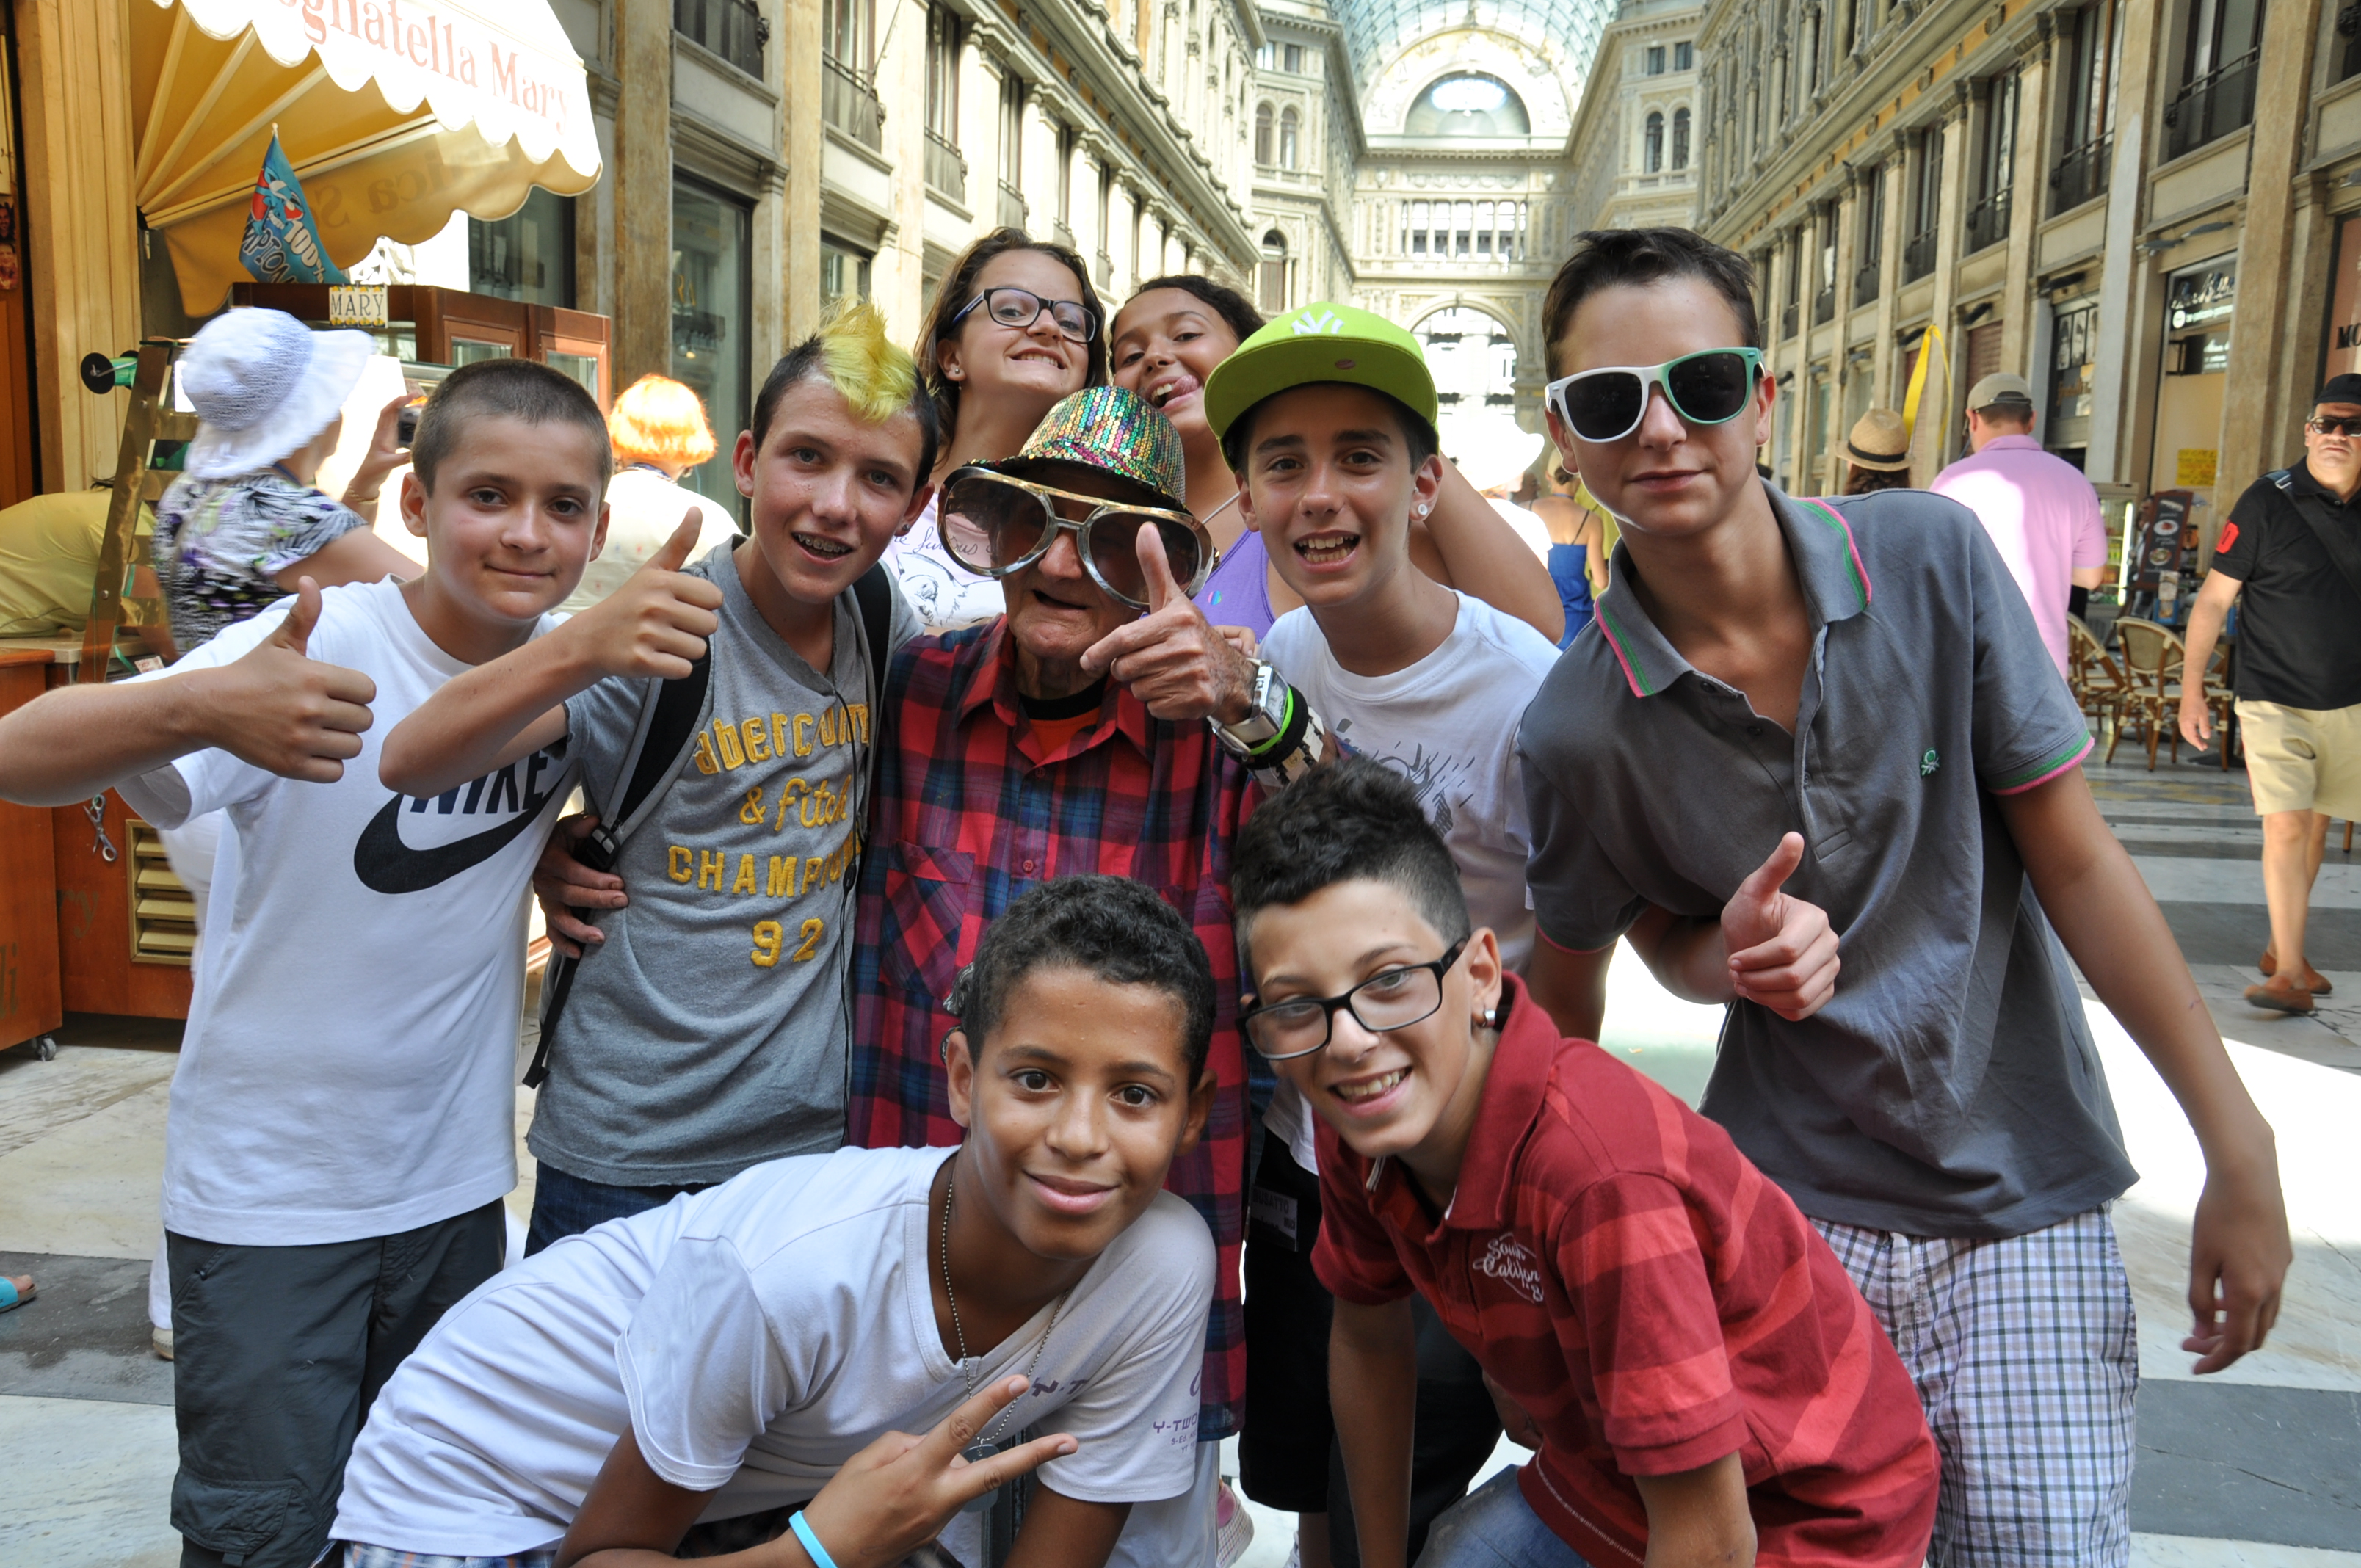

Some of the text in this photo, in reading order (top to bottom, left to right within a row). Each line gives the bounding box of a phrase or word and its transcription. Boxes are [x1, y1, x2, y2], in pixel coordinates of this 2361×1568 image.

[488, 40, 570, 137] Mary
[330, 294, 384, 316] MARY
[739, 785, 767, 825] &
